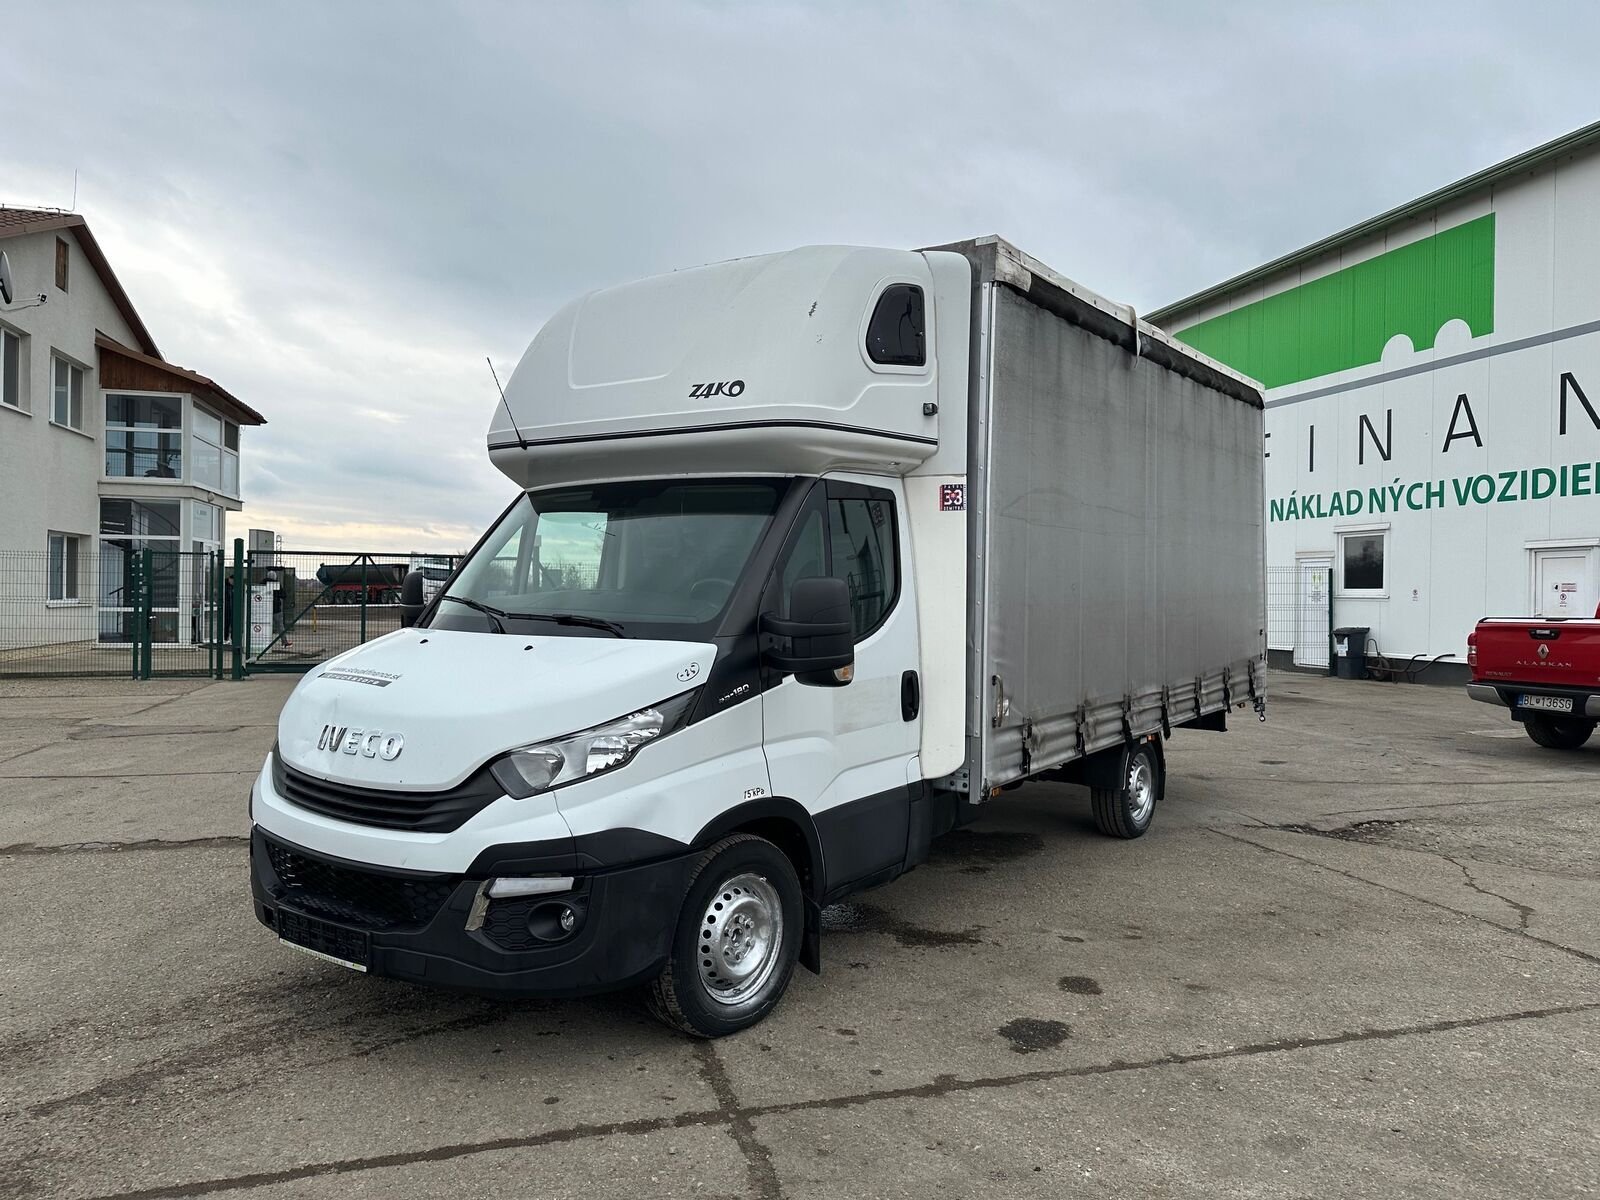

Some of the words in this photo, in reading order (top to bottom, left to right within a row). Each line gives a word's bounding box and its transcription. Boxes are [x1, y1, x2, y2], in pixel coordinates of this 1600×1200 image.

[688, 379, 745, 399] ZAKO
[1270, 478, 1444, 522] NÁKLADNÝCH
[1516, 660, 1572, 668] ALASKAN
[317, 724, 405, 761] IVECO
